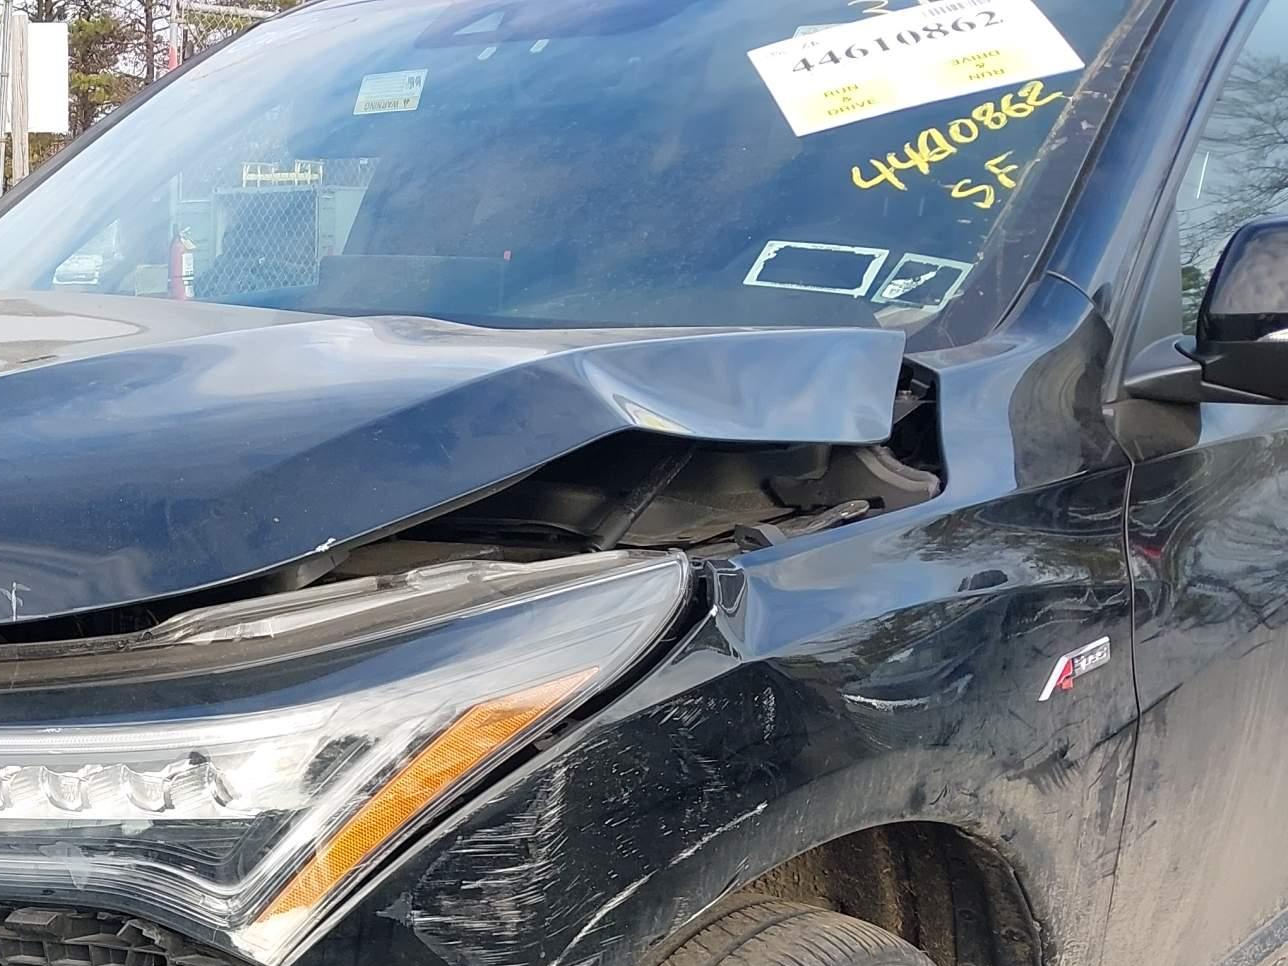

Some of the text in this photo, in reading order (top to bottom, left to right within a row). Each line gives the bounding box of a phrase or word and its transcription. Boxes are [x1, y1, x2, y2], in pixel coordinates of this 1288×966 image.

[792, 10, 1004, 73] 44610862
[823, 83, 859, 98] RUN
[827, 98, 878, 116] DRIVE
